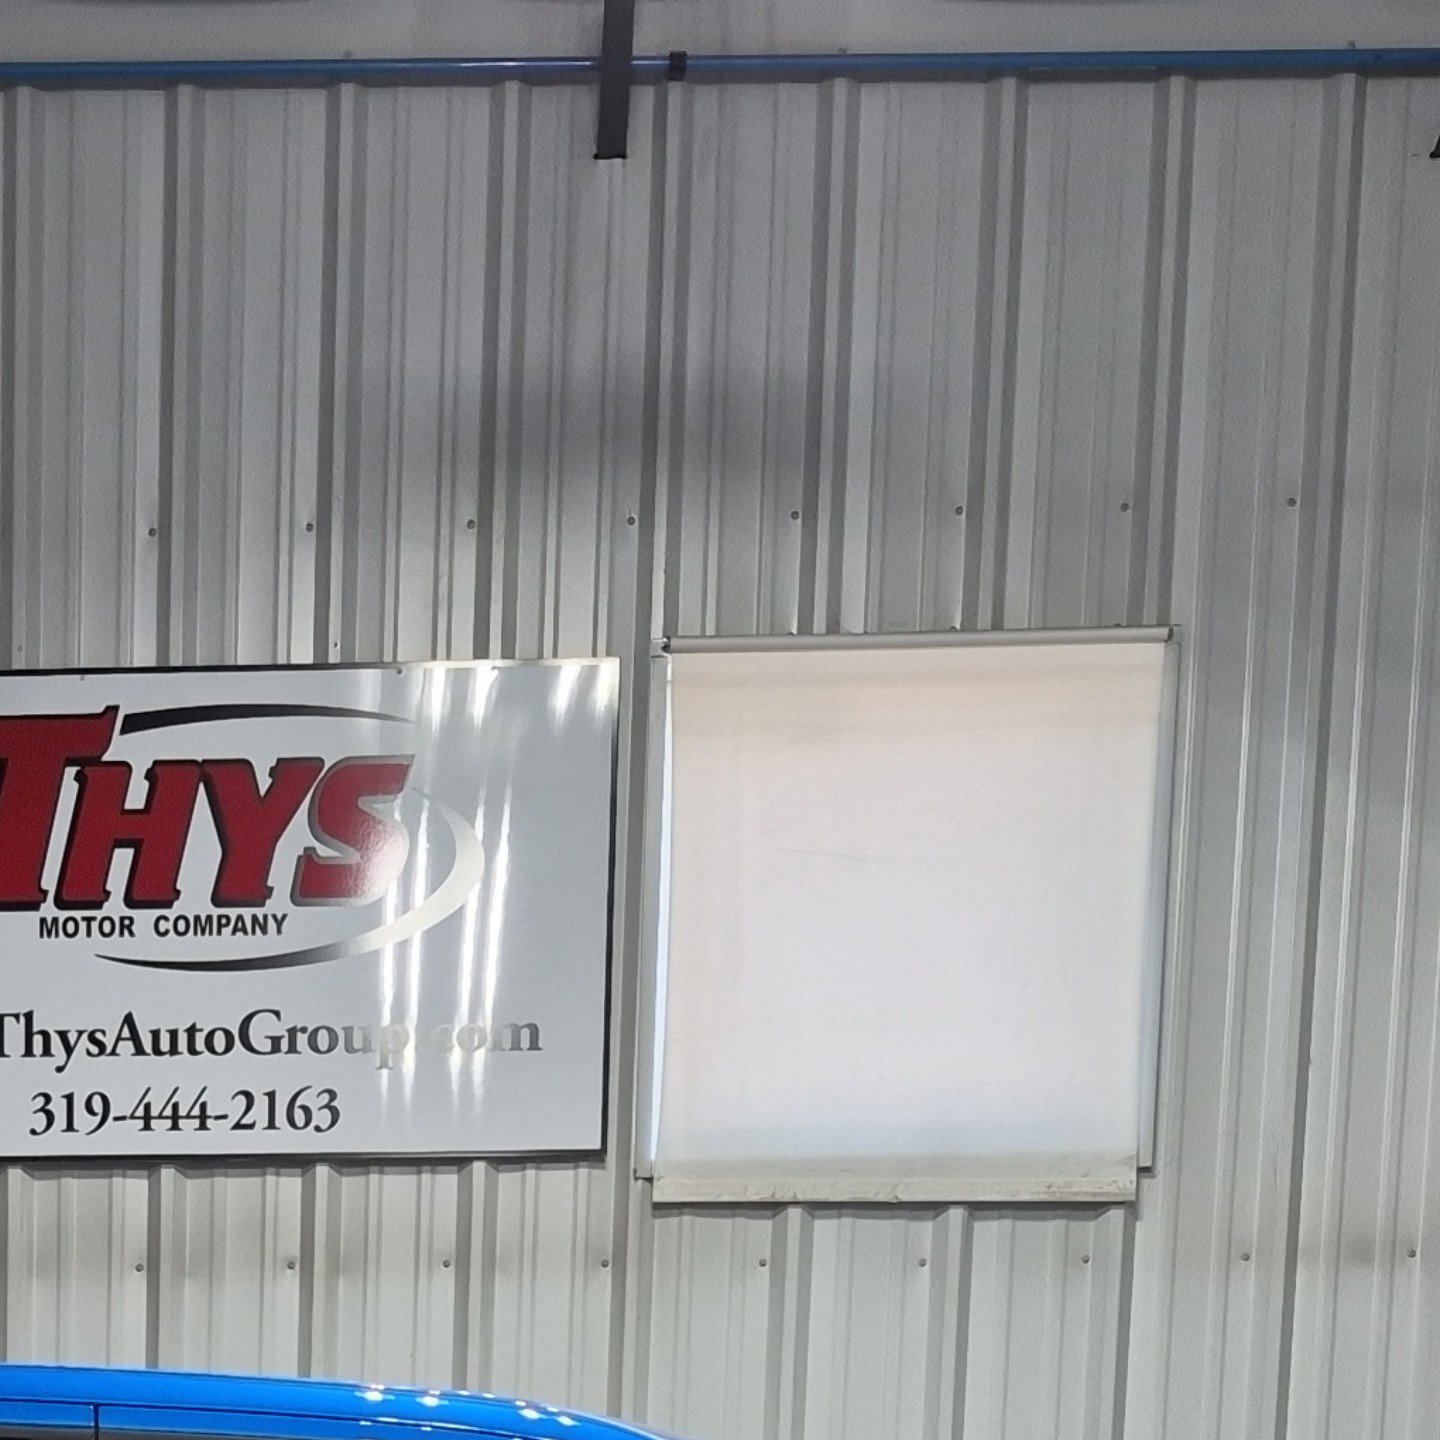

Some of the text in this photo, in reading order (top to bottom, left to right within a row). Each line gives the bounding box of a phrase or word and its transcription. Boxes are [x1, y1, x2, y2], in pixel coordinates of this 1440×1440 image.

[38, 911, 289, 940] MOTOR COMPANY
[27, 1084, 342, 1138] 319-444-2163
